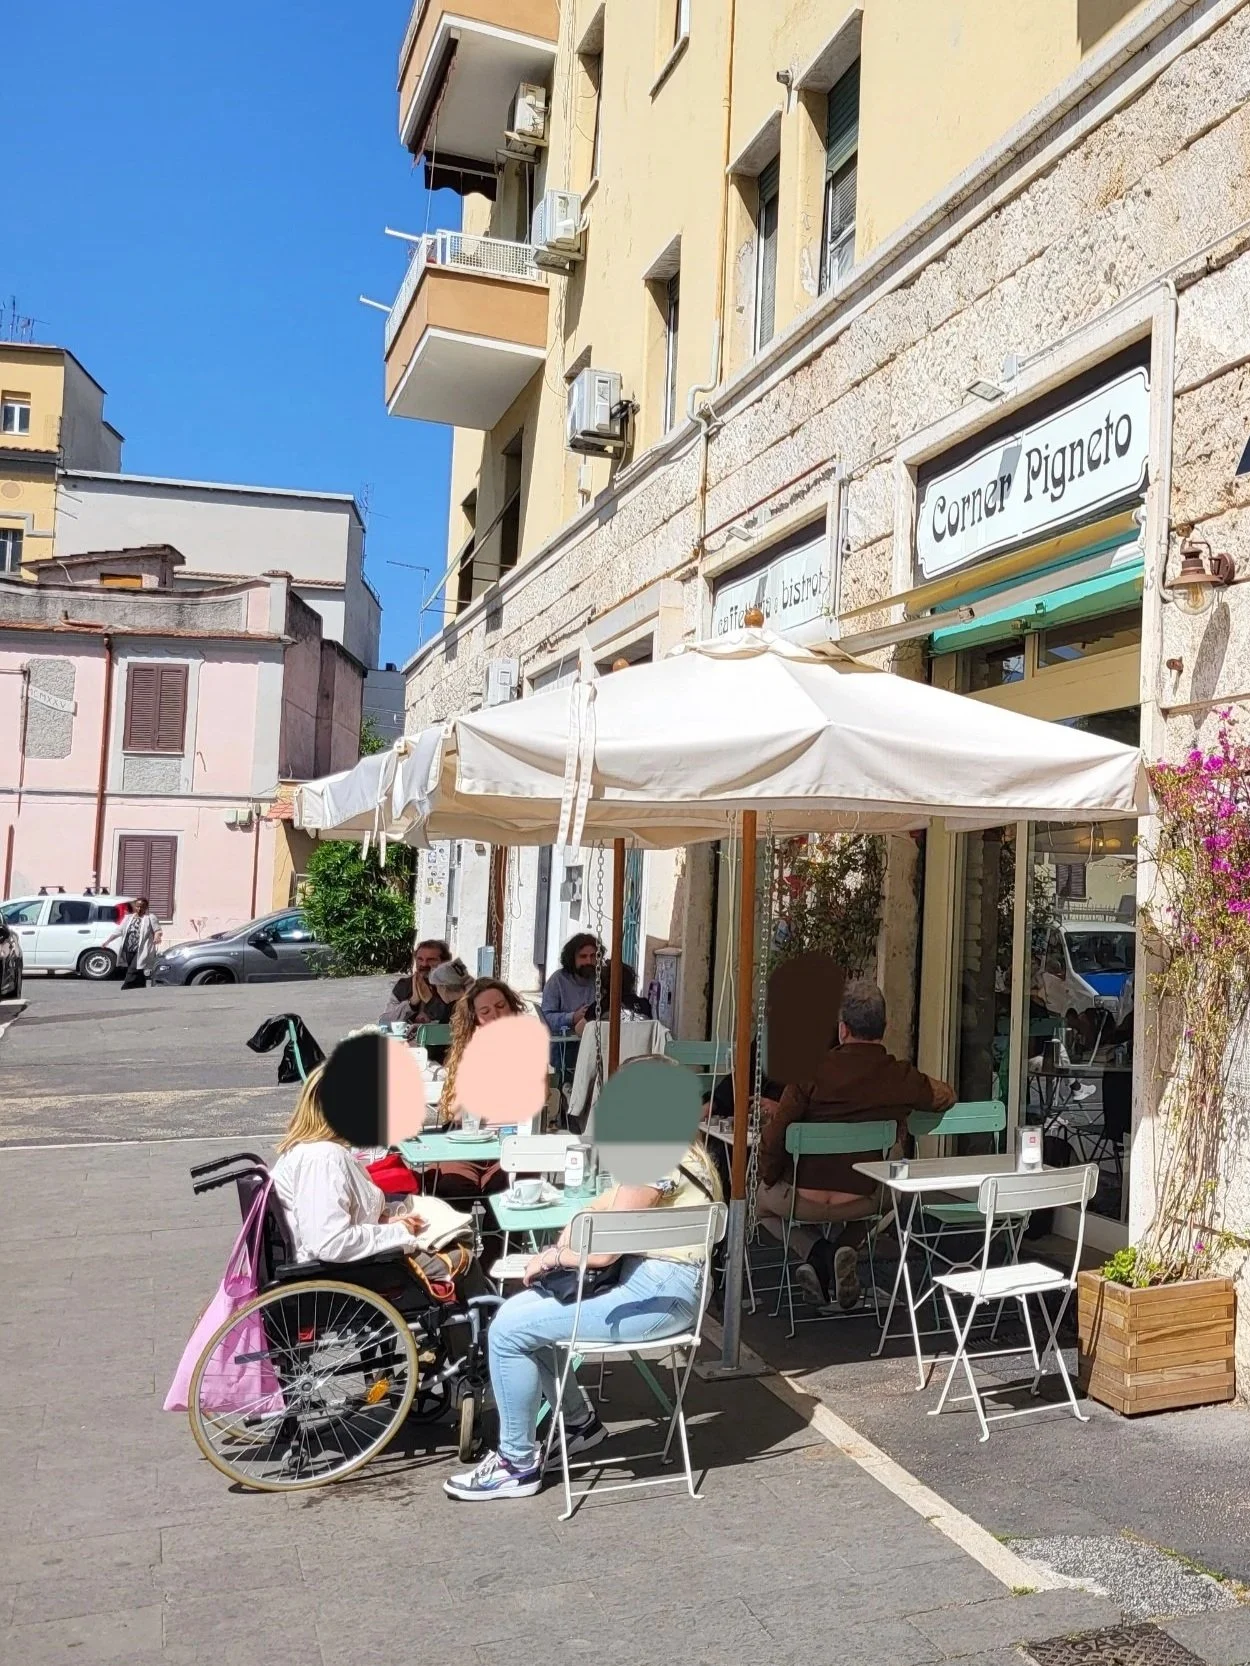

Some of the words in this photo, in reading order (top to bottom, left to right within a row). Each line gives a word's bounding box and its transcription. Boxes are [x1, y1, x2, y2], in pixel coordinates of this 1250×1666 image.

[932, 472, 1012, 543] Corner
[1023, 409, 1132, 503] Pigneto
[782, 564, 824, 610] bistrot
[1071, 1633, 1132, 1653] GAS
